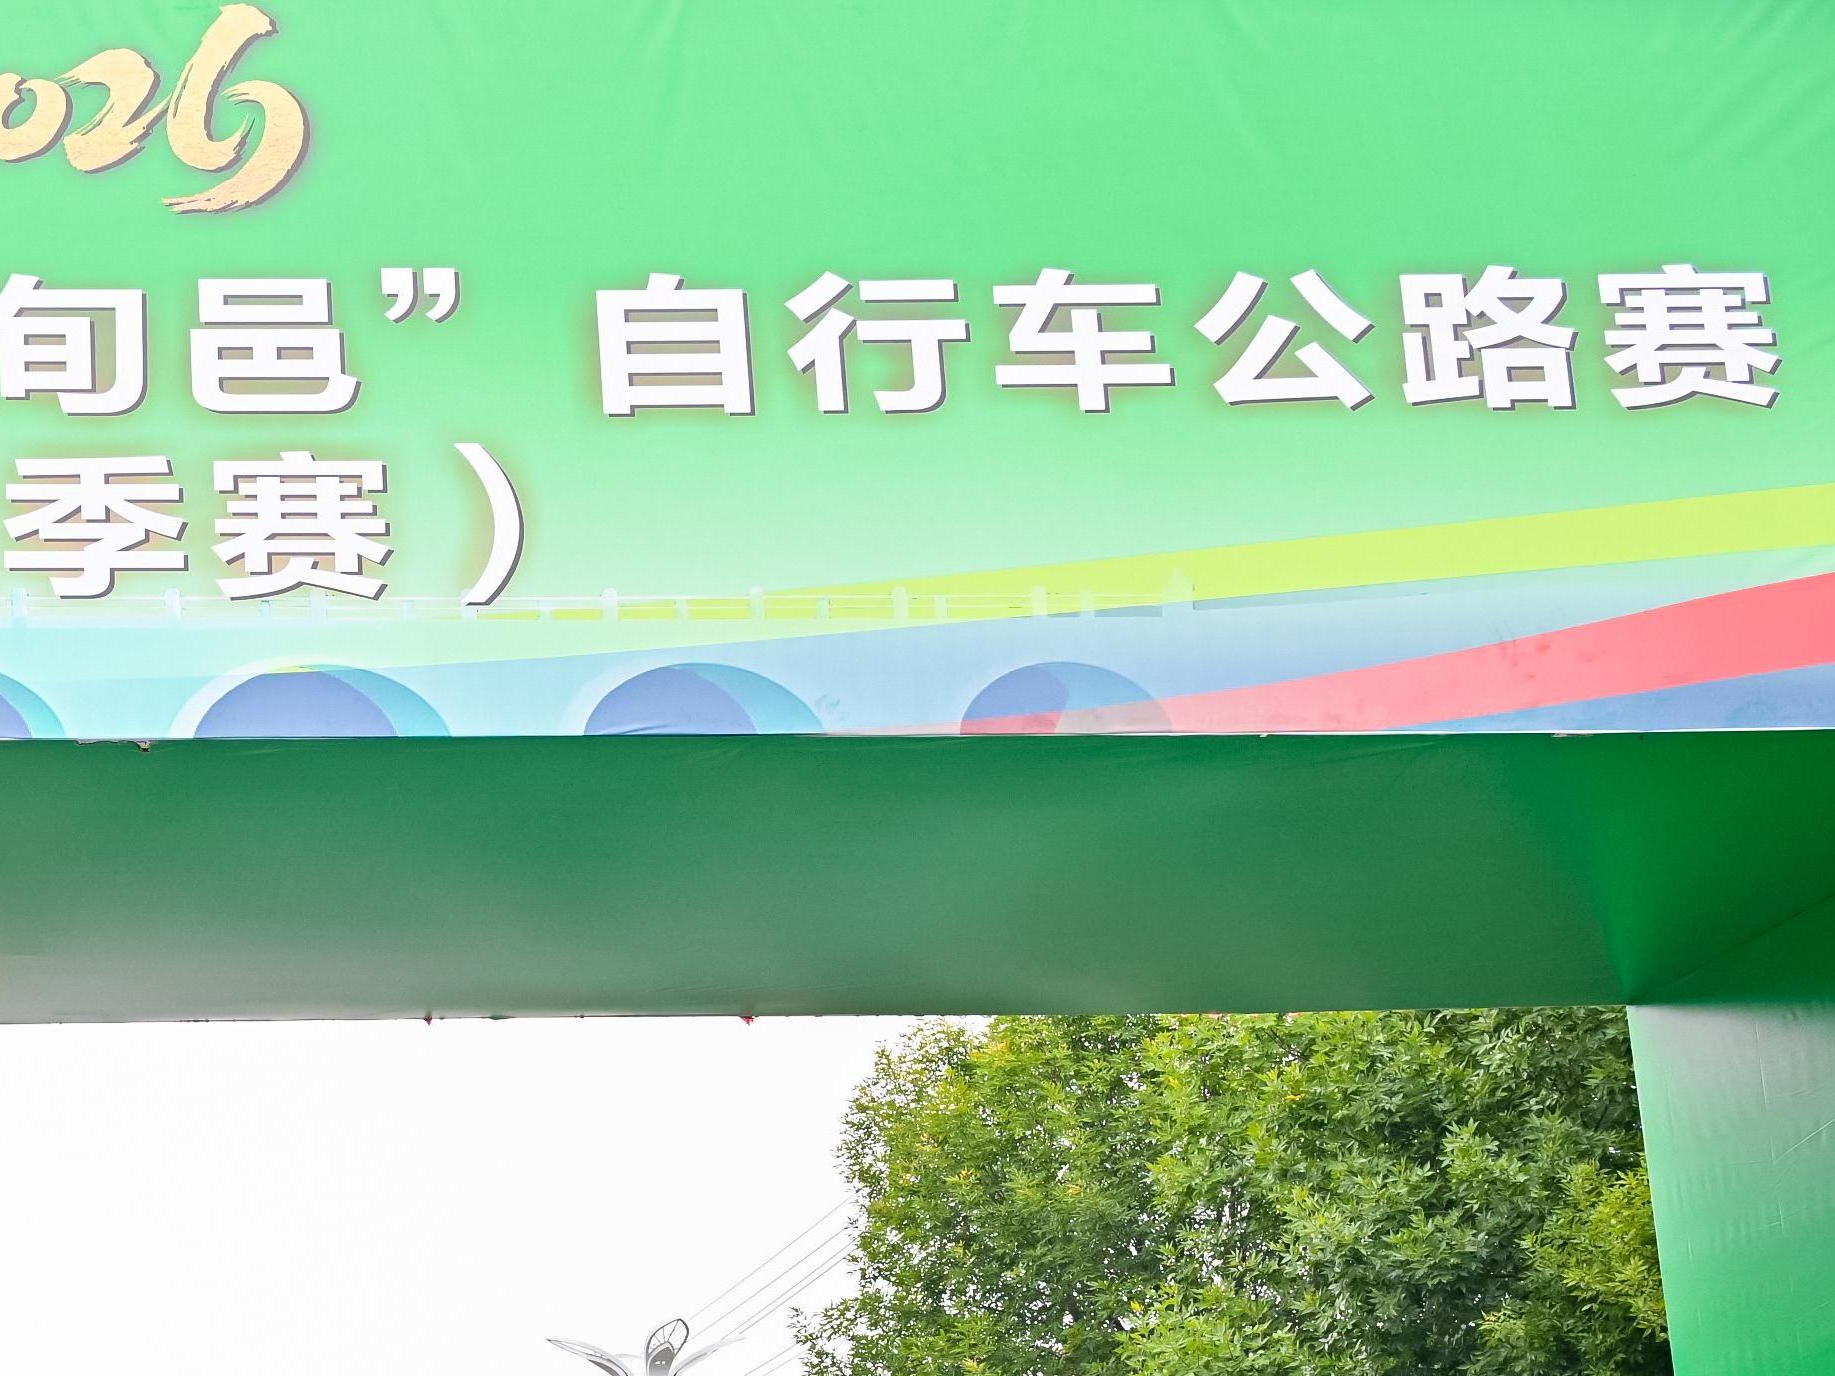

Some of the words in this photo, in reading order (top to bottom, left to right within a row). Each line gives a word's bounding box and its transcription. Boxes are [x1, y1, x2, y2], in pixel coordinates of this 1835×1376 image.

[594, 264, 1783, 414] 自行车公路赛
